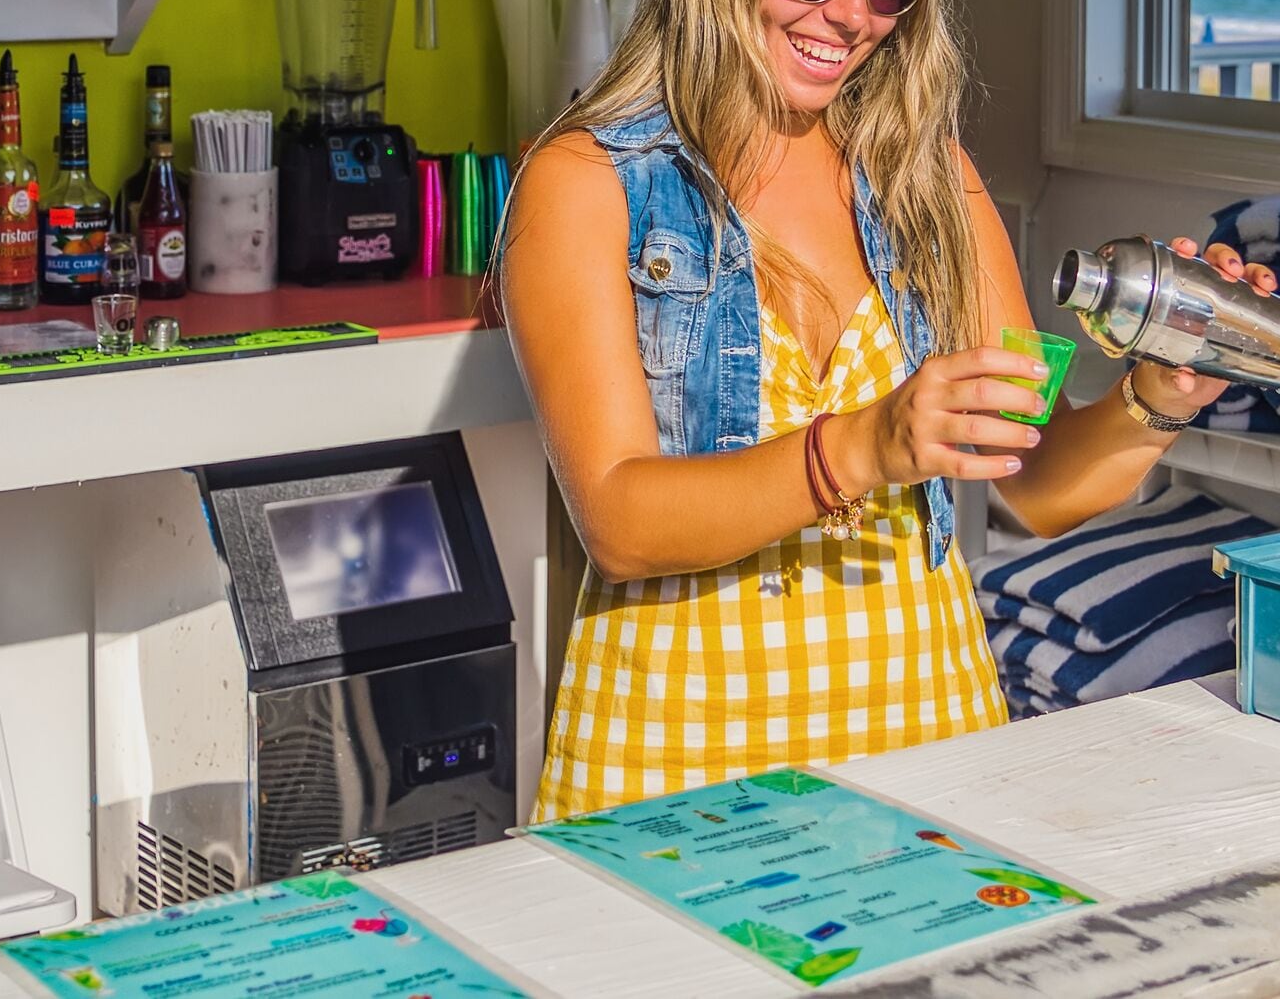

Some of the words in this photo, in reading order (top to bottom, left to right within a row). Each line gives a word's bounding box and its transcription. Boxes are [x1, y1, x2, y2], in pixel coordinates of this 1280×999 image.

[47, 259, 71, 270] BLUE
[72, 258, 104, 270] CURA
[154, 914, 234, 937] COCKTAILS
